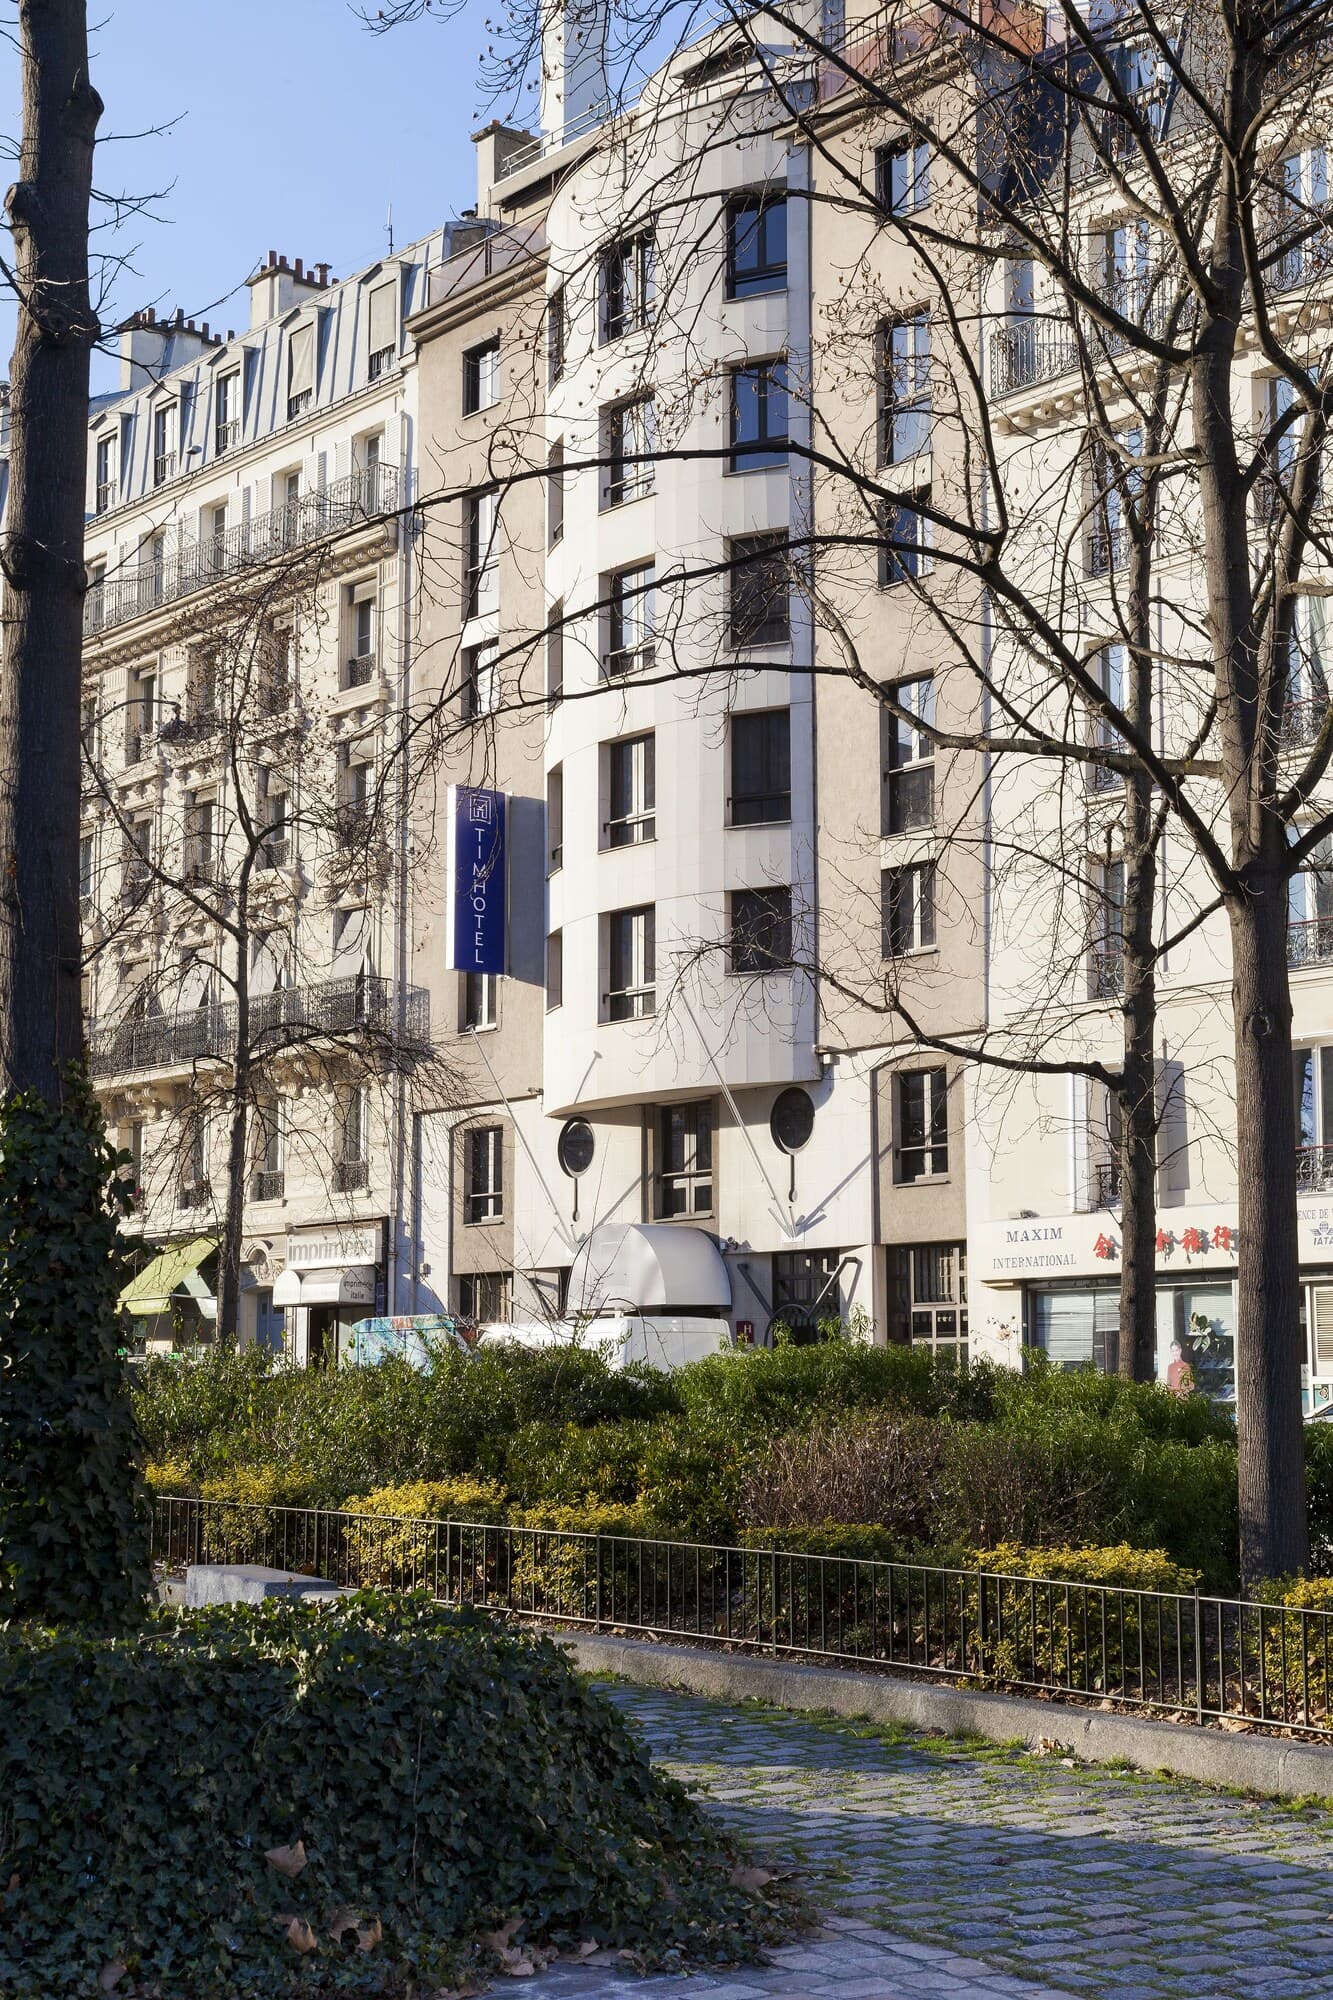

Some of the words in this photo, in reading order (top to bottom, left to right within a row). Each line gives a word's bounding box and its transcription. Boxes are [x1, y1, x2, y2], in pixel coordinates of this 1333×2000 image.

[472, 828, 487, 964] TIMHOTEL
[1006, 1227, 1063, 1243] MAXIM
[993, 1253, 1077, 1269] INTERNATIONAL
